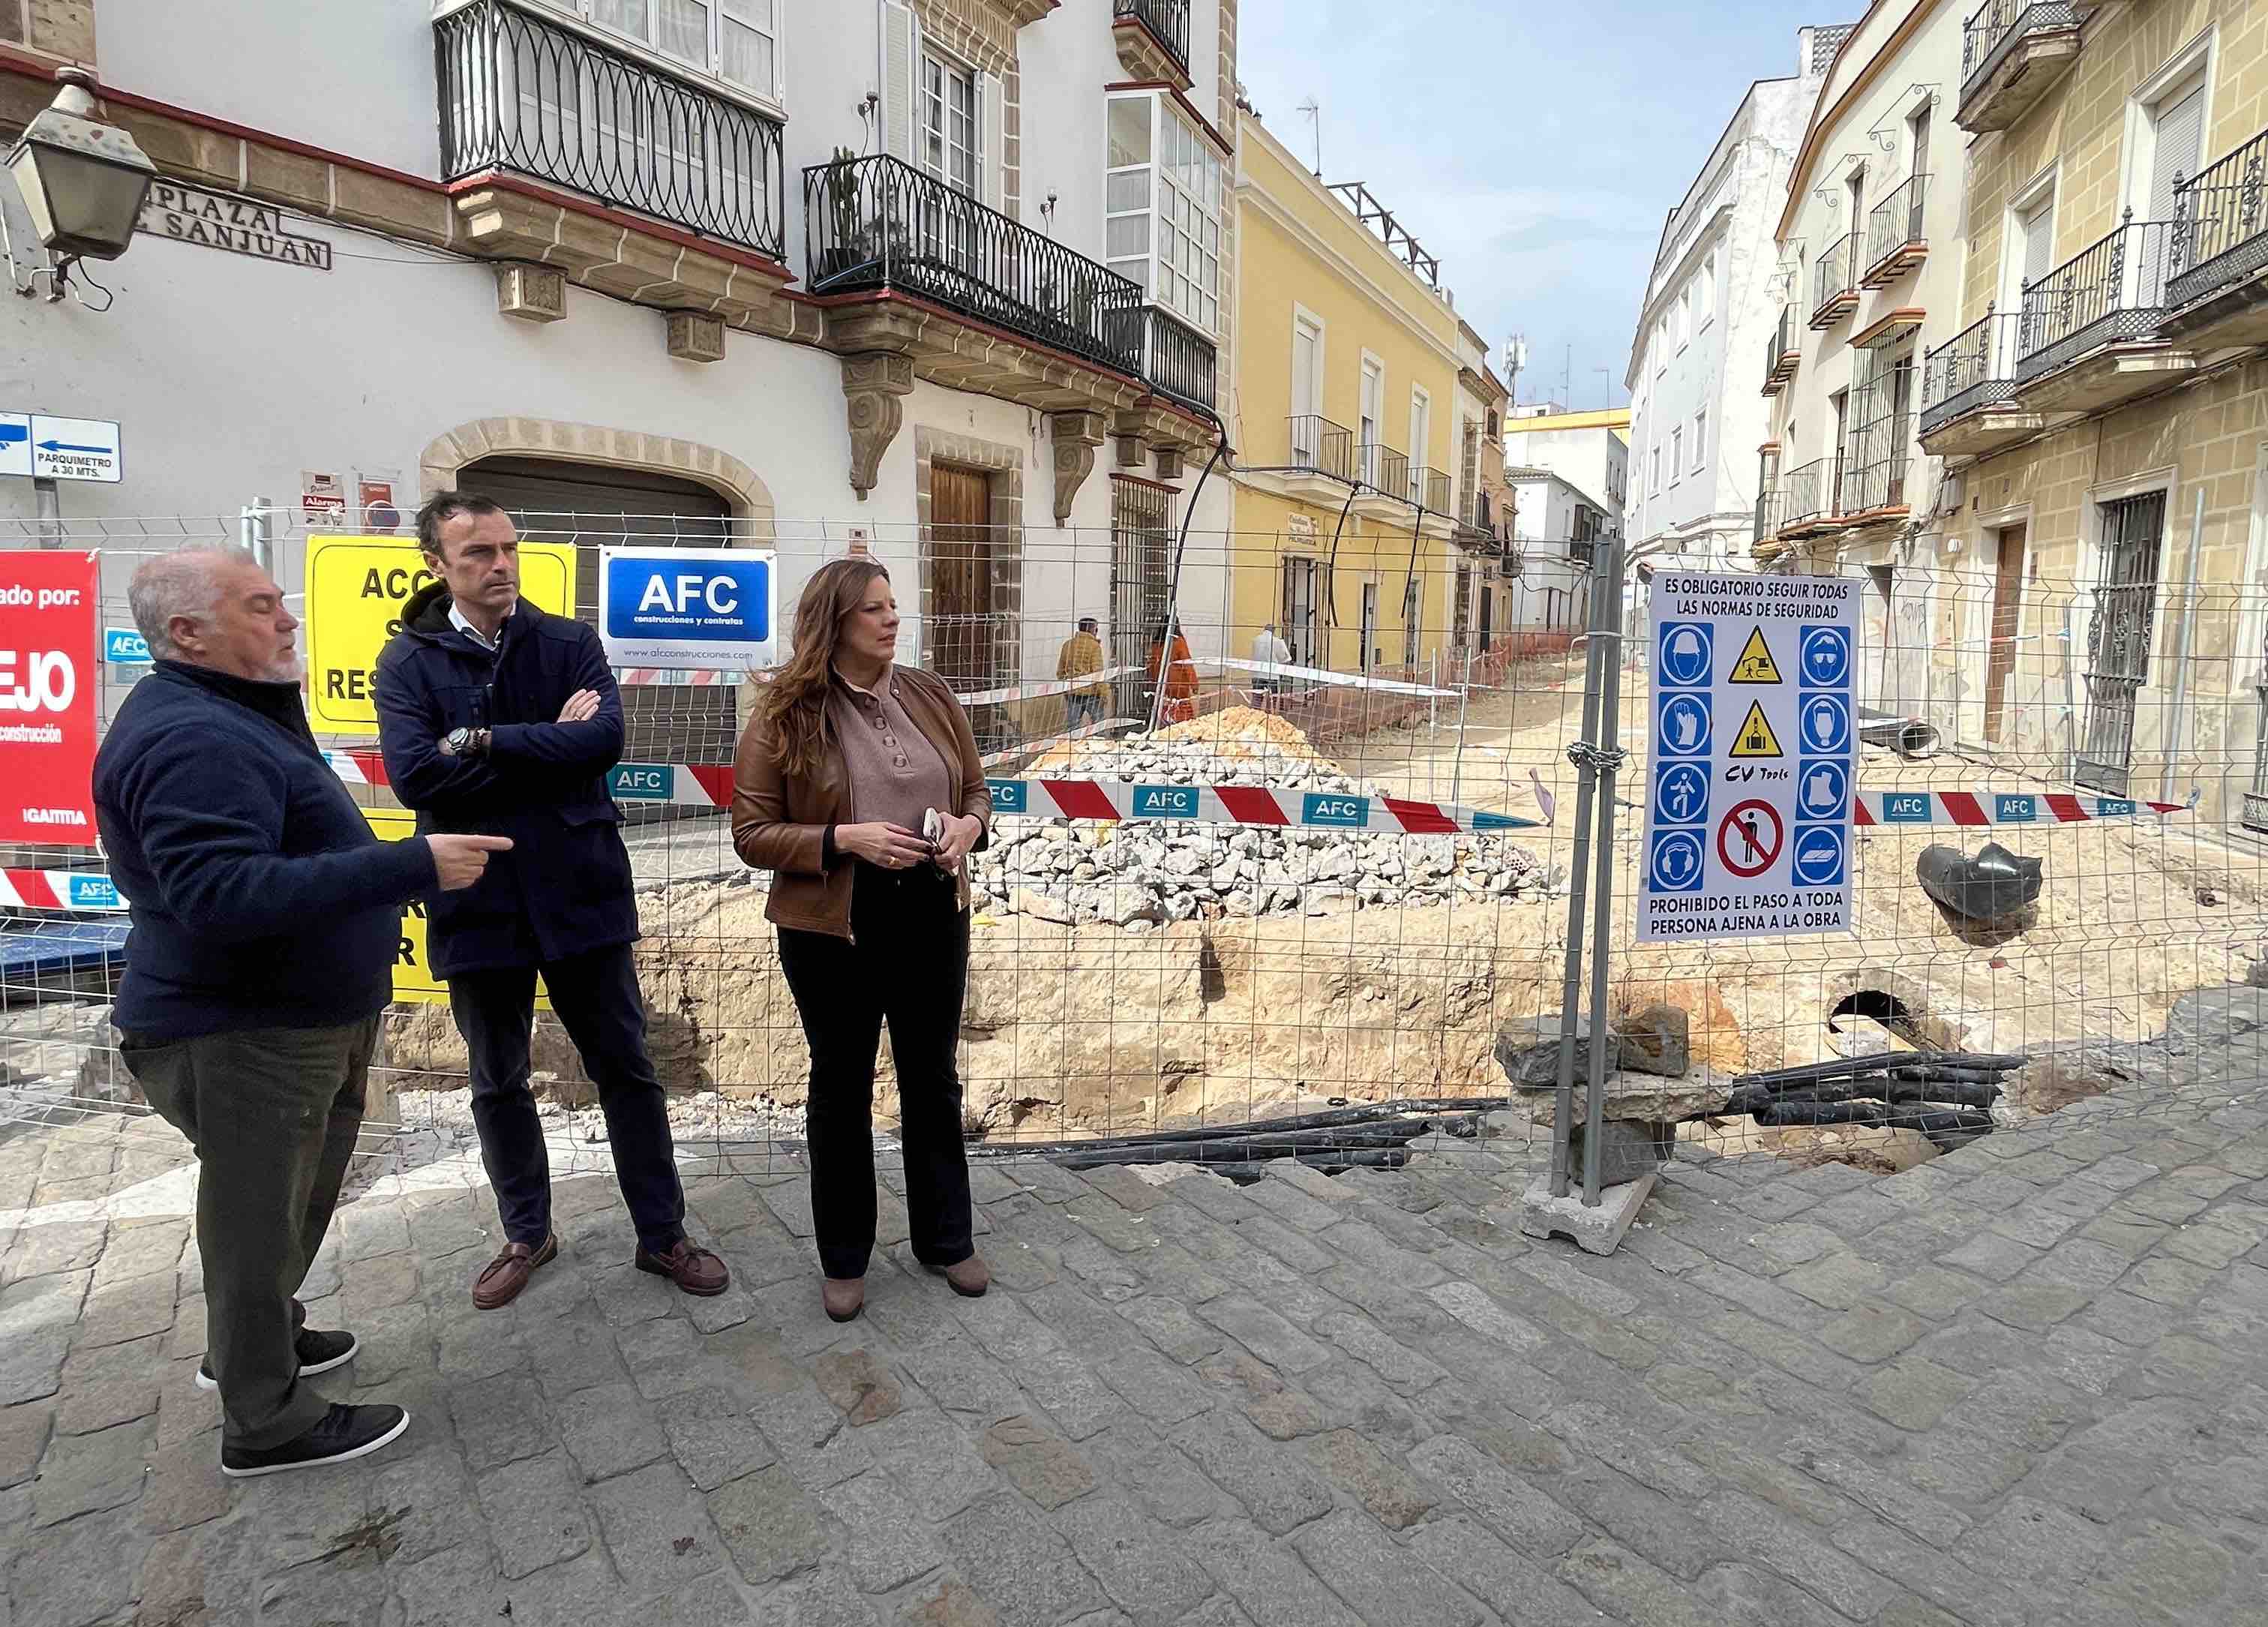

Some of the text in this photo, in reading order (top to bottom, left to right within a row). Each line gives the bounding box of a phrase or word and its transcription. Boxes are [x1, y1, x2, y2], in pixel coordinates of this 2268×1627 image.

[155, 186, 271, 232] PLAZA
[38, 453, 112, 468] PARQUIMETRO
[52, 465, 100, 477] A 30 MTS.
[638, 575, 738, 614] AFC
[1665, 578, 1848, 599] ES OBLIGATORIO SEGUIR TODAS
[38, 588, 80, 610] por:
[1677, 599, 1838, 619] LAS NORMAS DE SEGURIDAD
[634, 615, 744, 626] construcciones y contratas
[616, 770, 661, 788] AFC
[1725, 764, 1754, 782] CV
[990, 786, 1015, 802] FC
[1145, 791, 1187, 808] AFC
[1315, 800, 1357, 817] AFC
[1892, 798, 1923, 813] AFC
[2002, 798, 2029, 813] AFC
[1649, 891, 1843, 914] PROHIBIDO EL PASO A TODA
[1651, 911, 1841, 935] PERSONA AJENA A LA OBRA
